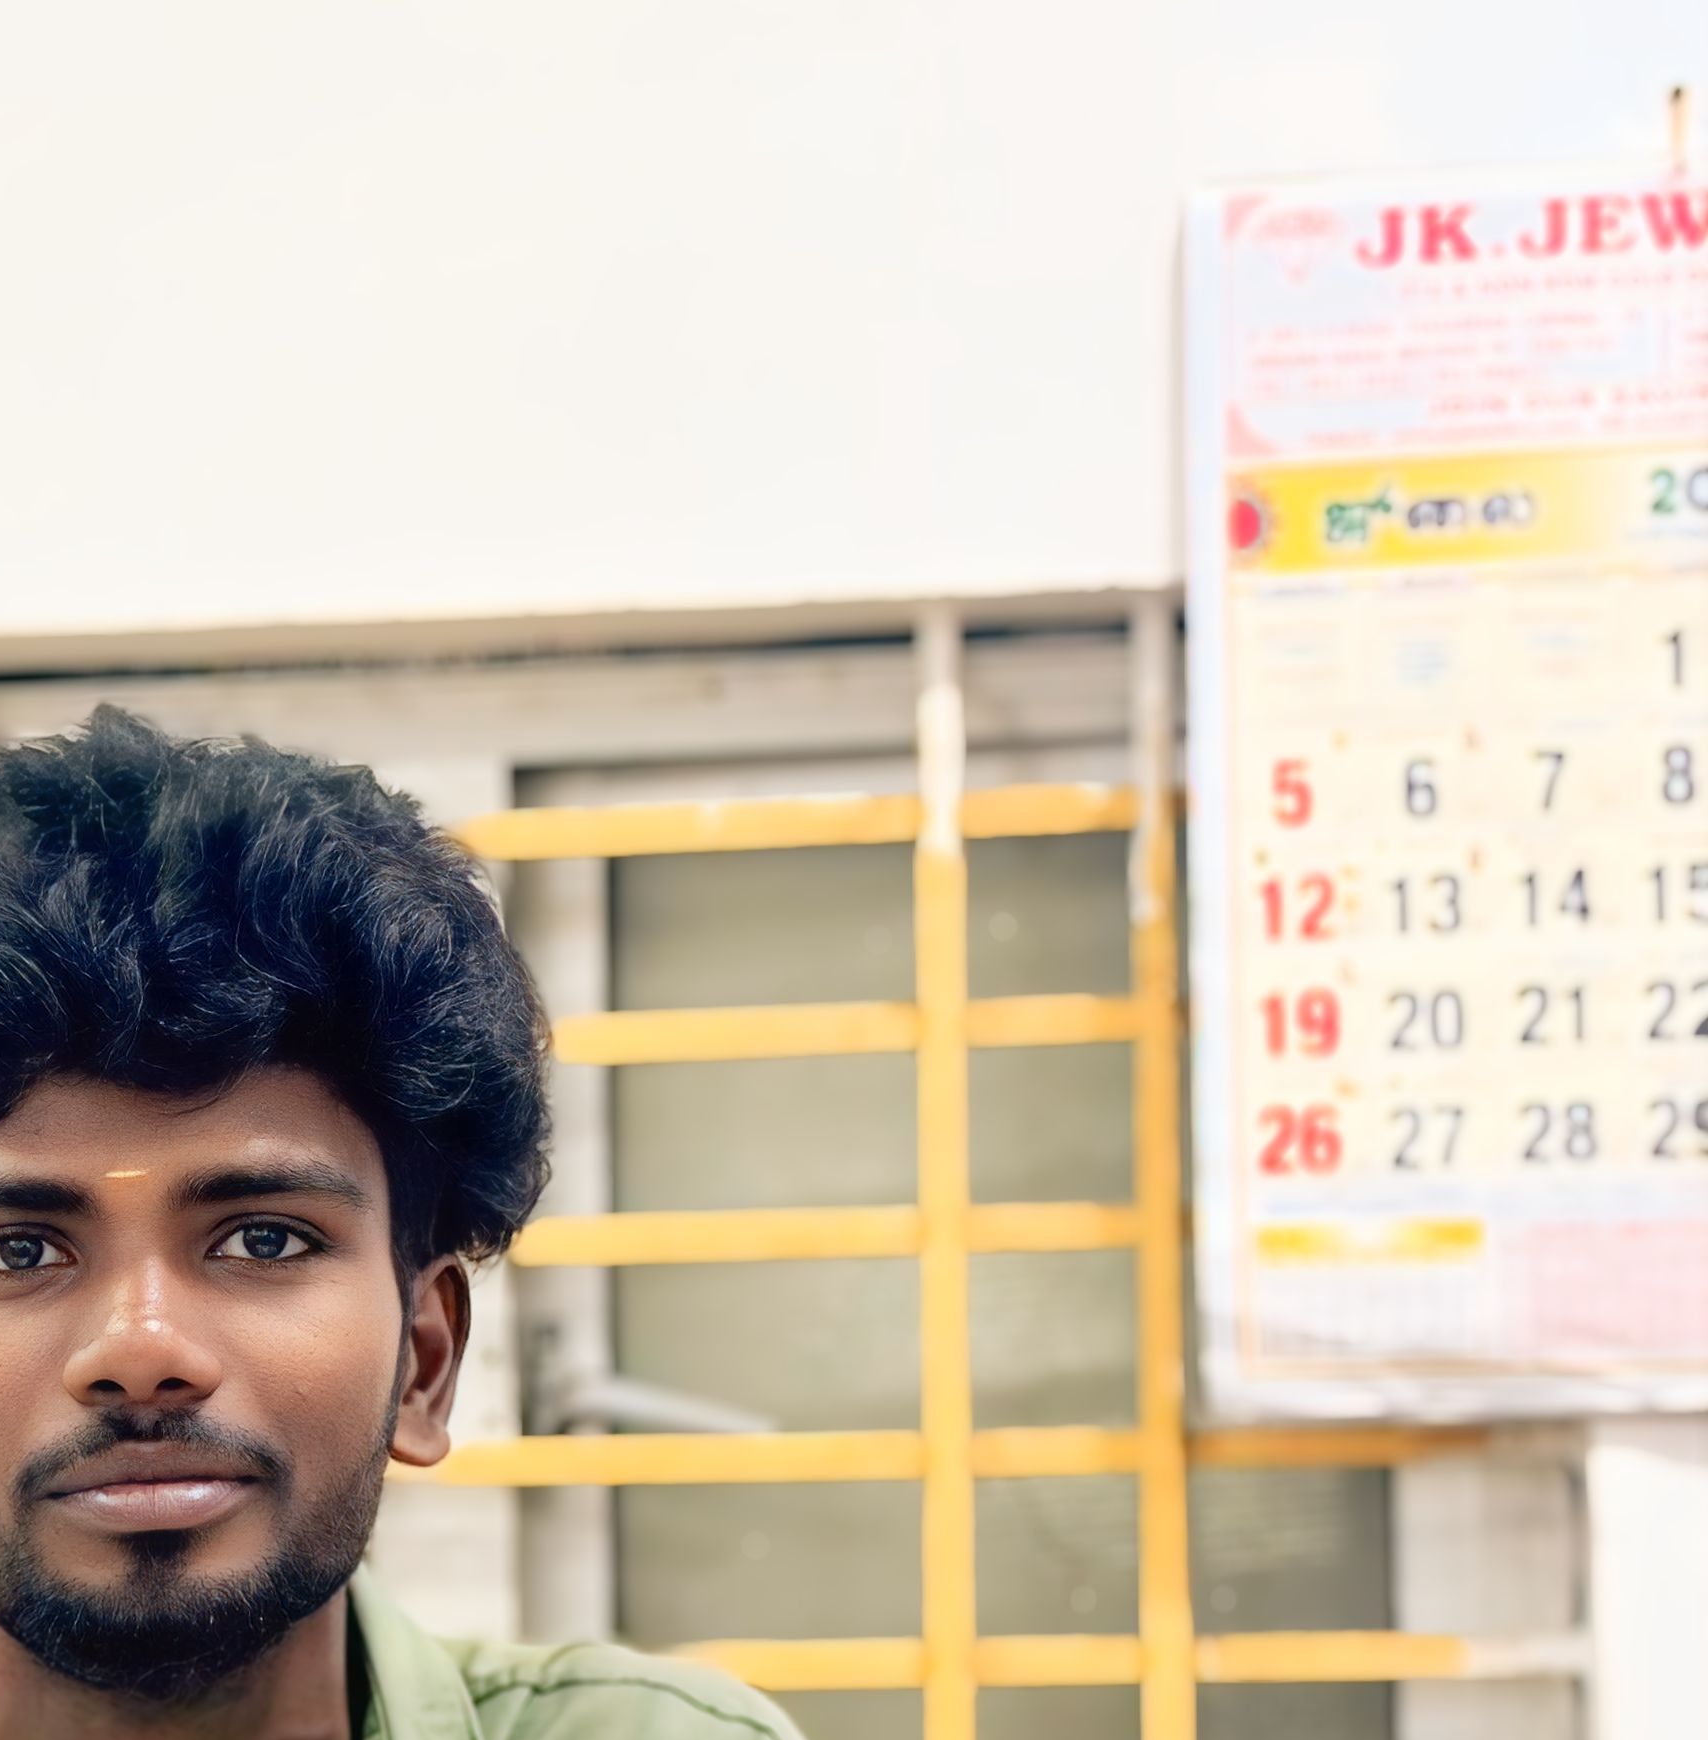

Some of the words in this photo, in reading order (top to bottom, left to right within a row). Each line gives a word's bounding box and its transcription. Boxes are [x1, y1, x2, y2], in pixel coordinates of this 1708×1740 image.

[1663, 628, 1685, 688] 1
[1271, 756, 1314, 828] 5
[1405, 756, 1438, 818] 6
[1533, 748, 1566, 813] 7
[1662, 744, 1695, 805] 8
[1259, 871, 1337, 943] 12
[1392, 872, 1463, 934] 13
[1521, 866, 1592, 927] 14
[1260, 986, 1341, 1060] 19
[1389, 990, 1465, 1051] 20
[1518, 985, 1588, 1043] 21
[1258, 1104, 1343, 1176] 26
[1390, 1105, 1465, 1171] 27
[1520, 1102, 1598, 1162] 28
